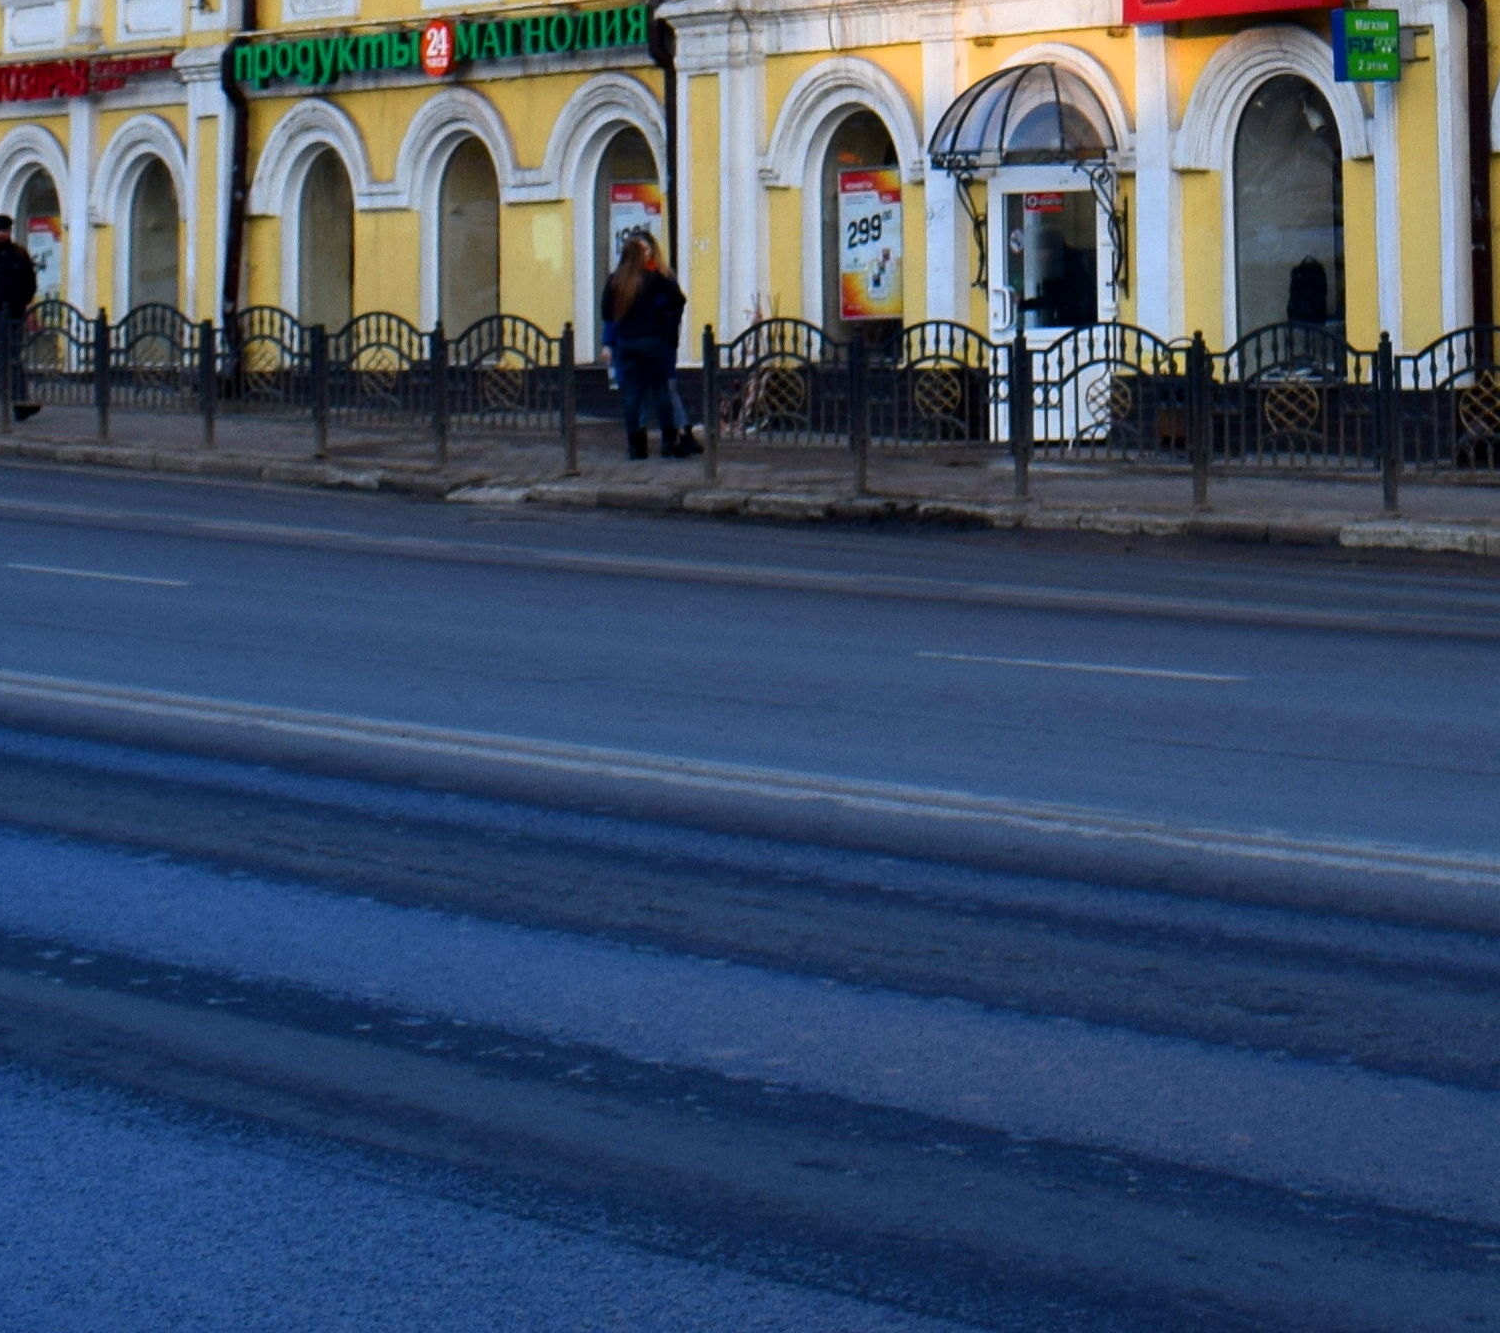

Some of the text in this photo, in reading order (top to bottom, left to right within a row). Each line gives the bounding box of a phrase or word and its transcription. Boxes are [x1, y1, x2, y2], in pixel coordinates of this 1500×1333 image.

[426, 26, 448, 56] 24
[454, 4, 649, 60] МАГНОЛИЯ
[234, 31, 420, 90] продукты
[847, 213, 882, 248] 299
